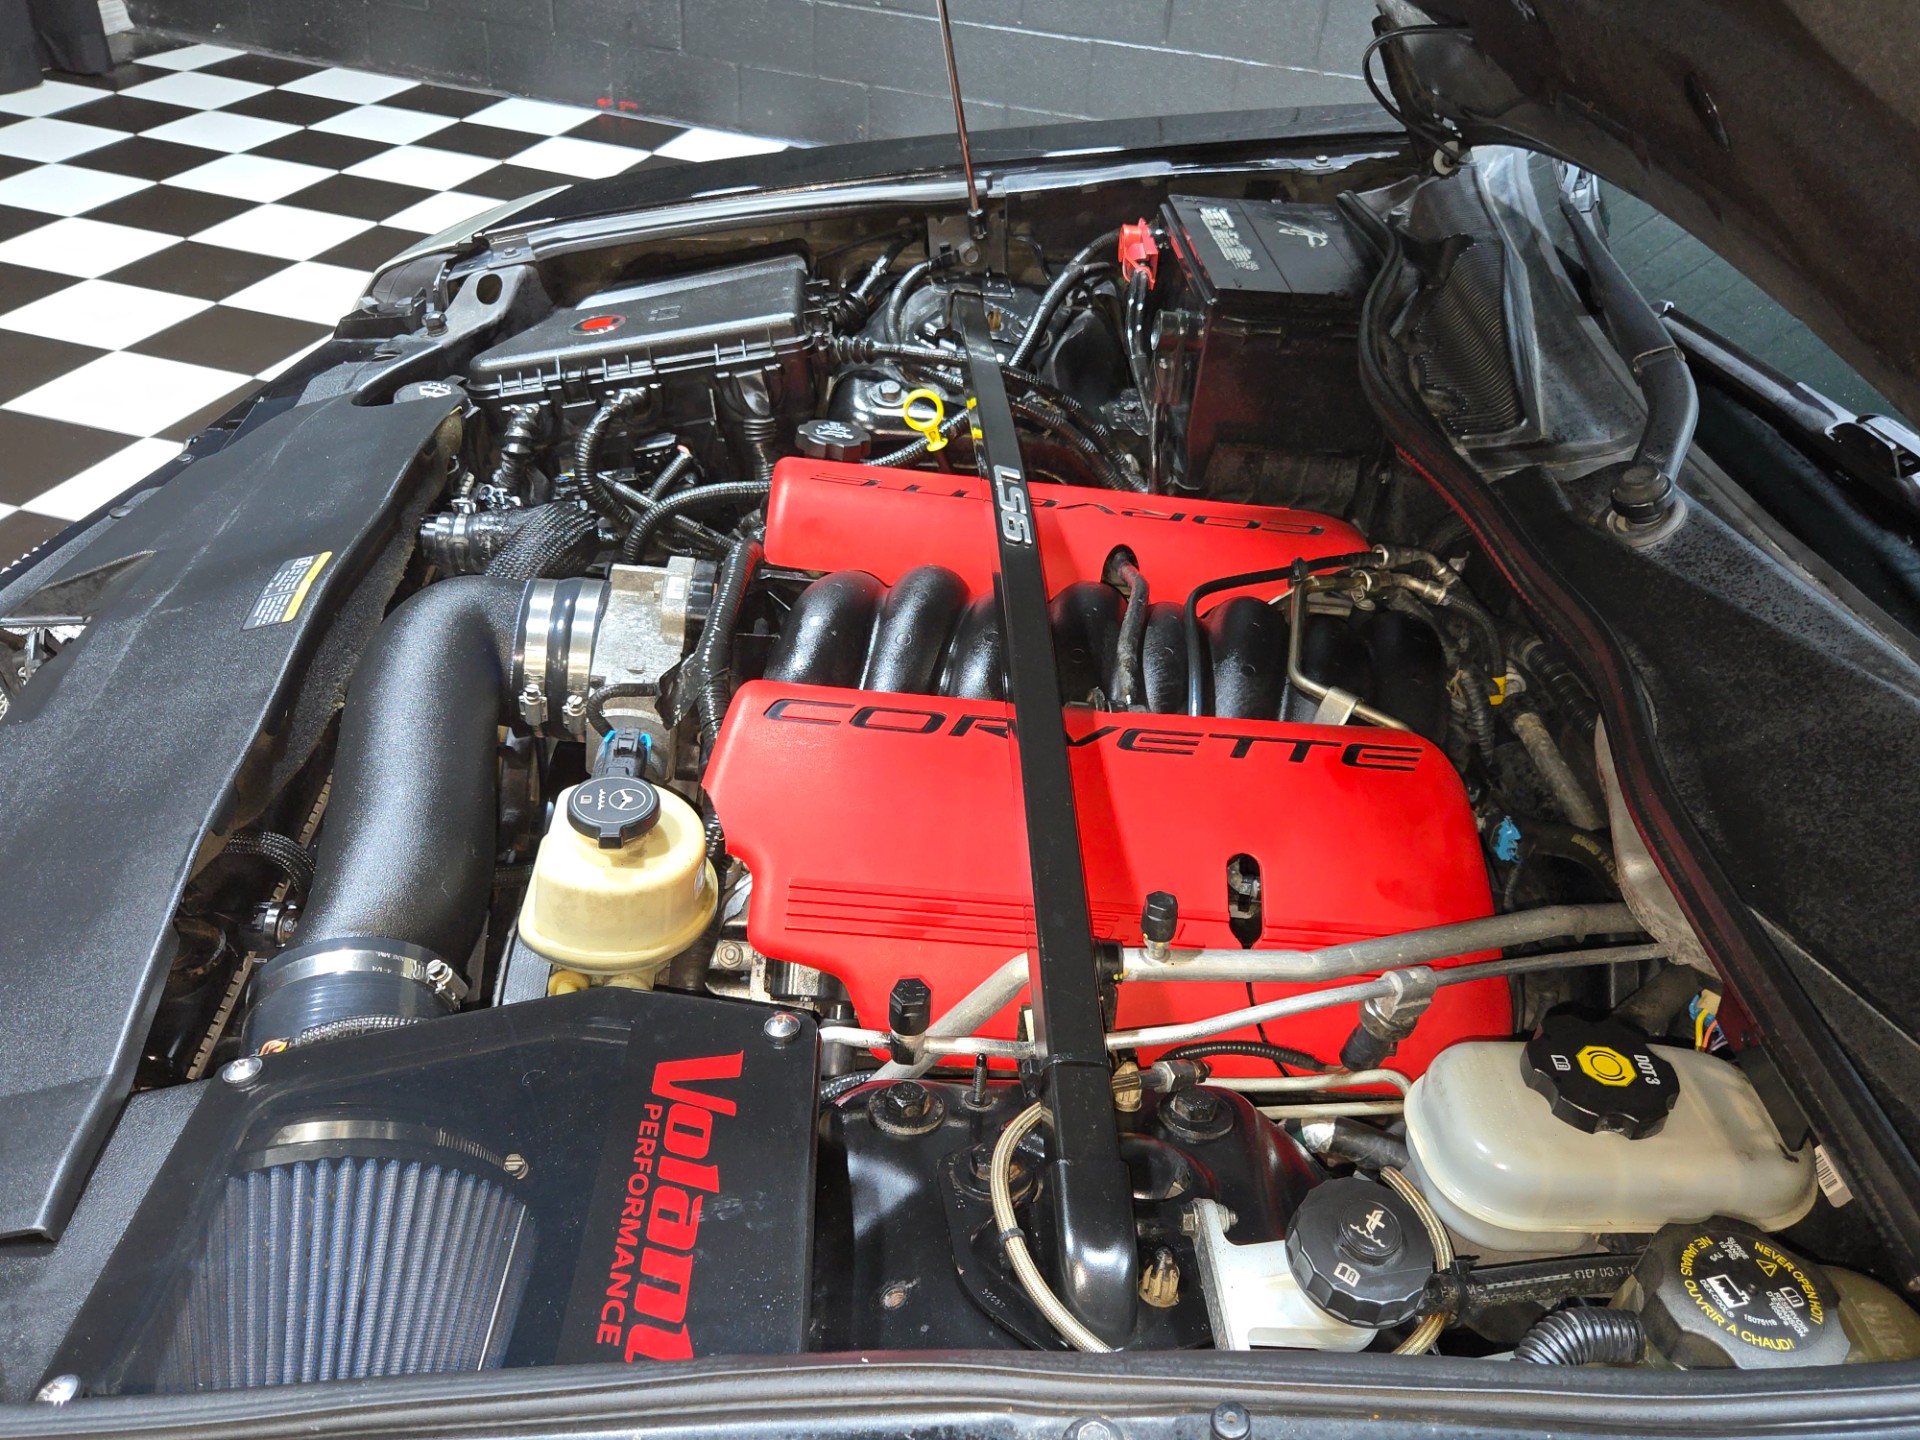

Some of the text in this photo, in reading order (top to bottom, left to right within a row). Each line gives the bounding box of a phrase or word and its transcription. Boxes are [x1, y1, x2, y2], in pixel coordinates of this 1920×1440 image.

[994, 465, 1032, 546] LS6
[1633, 1054, 1661, 1086] DOT 3
[597, 1103, 663, 1346] PERFORMANCE
[1694, 1236, 1714, 1249] NE
[1680, 1243, 1699, 1277] JAMAIS
[1684, 1279, 1726, 1327] OUVRIR
[1754, 1241, 1824, 1325] NEVER OPEN HOT!
[1741, 1330, 1795, 1350] CHAUD!
